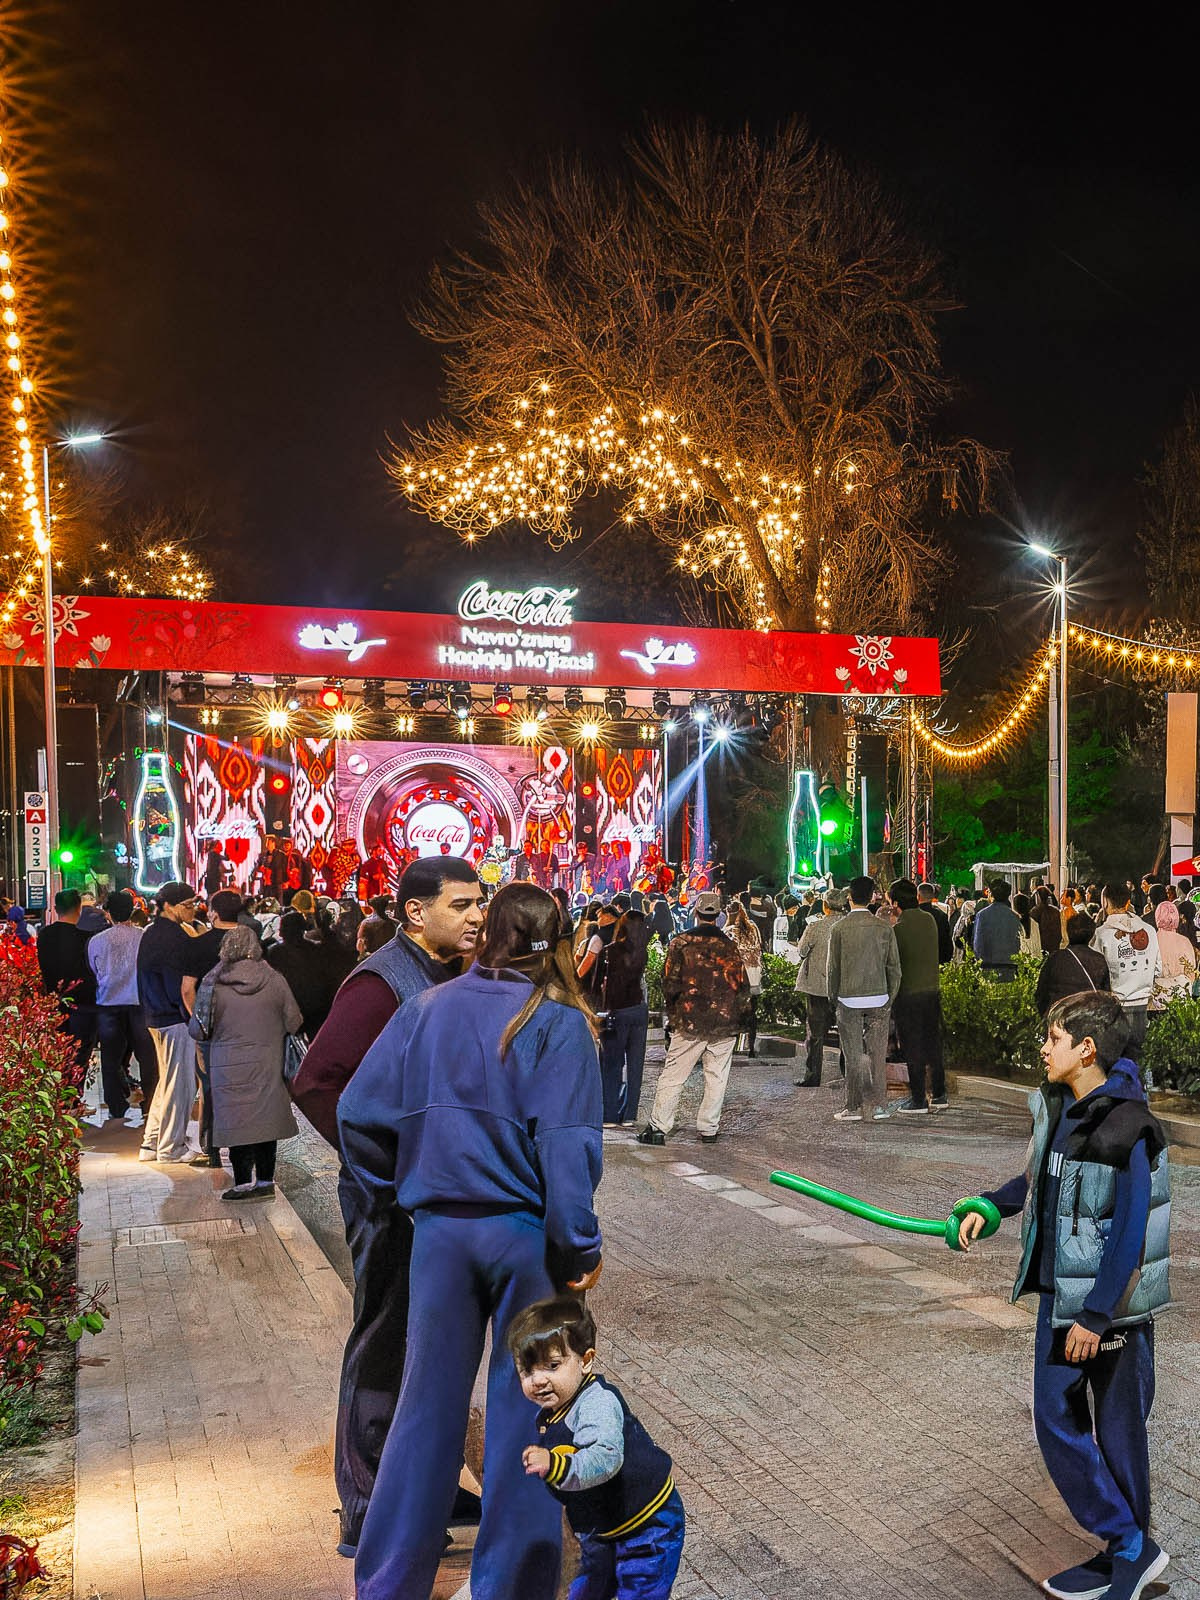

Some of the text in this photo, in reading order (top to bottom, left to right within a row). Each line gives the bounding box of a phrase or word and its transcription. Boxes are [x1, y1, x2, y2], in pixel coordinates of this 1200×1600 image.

[458, 581, 578, 626] Coca-Cola
[461, 626, 571, 652] Navro'zning
[438, 645, 594, 673] Haqiqiy Mo'jizasi
